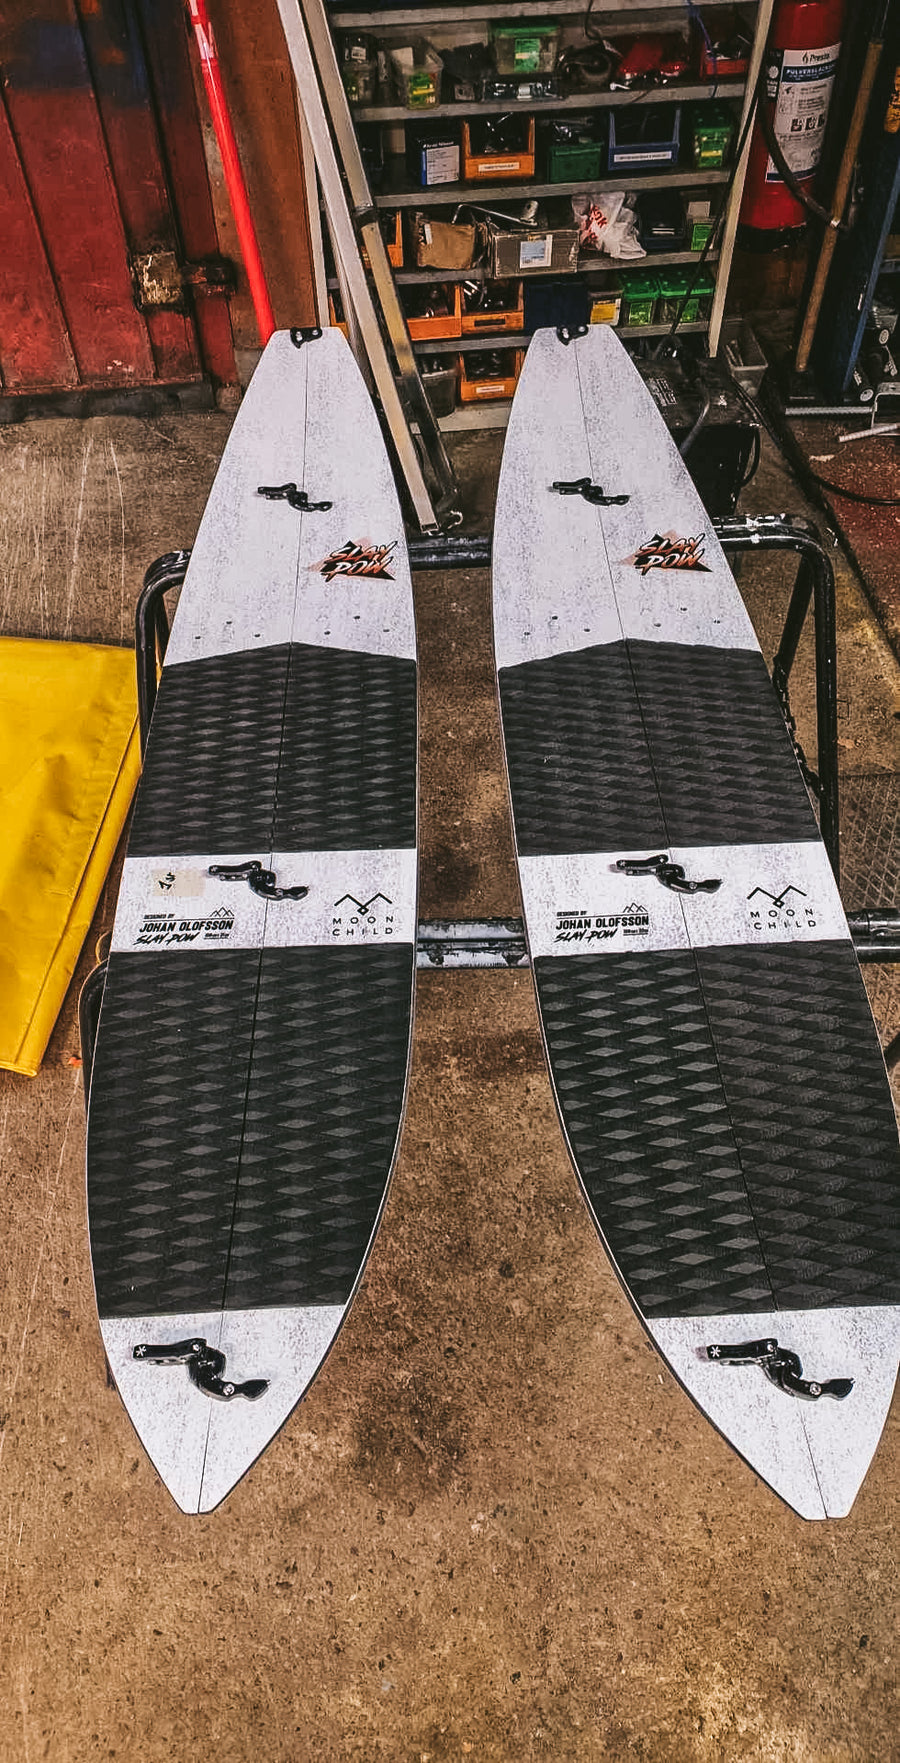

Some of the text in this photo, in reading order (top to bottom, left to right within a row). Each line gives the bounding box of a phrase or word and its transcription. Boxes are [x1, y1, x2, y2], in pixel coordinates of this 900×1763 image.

[325, 540, 398, 563] SLAY
[636, 533, 706, 556] SLAY
[321, 556, 394, 582] POW
[635, 548, 706, 576] POW
[750, 908, 814, 918] MOON
[139, 920, 234, 933] JOHAN OLOFSSON
[332, 916, 394, 925] MOON
[555, 916, 649, 930] JOHAN OLOFSSON
[753, 920, 817, 930] CHILD
[332, 927, 393, 936] CHILD
[553, 929, 588, 943] SLAY
[586, 928, 618, 944] POW
[132, 932, 168, 946] SLAY
[166, 932, 200, 946] POW
